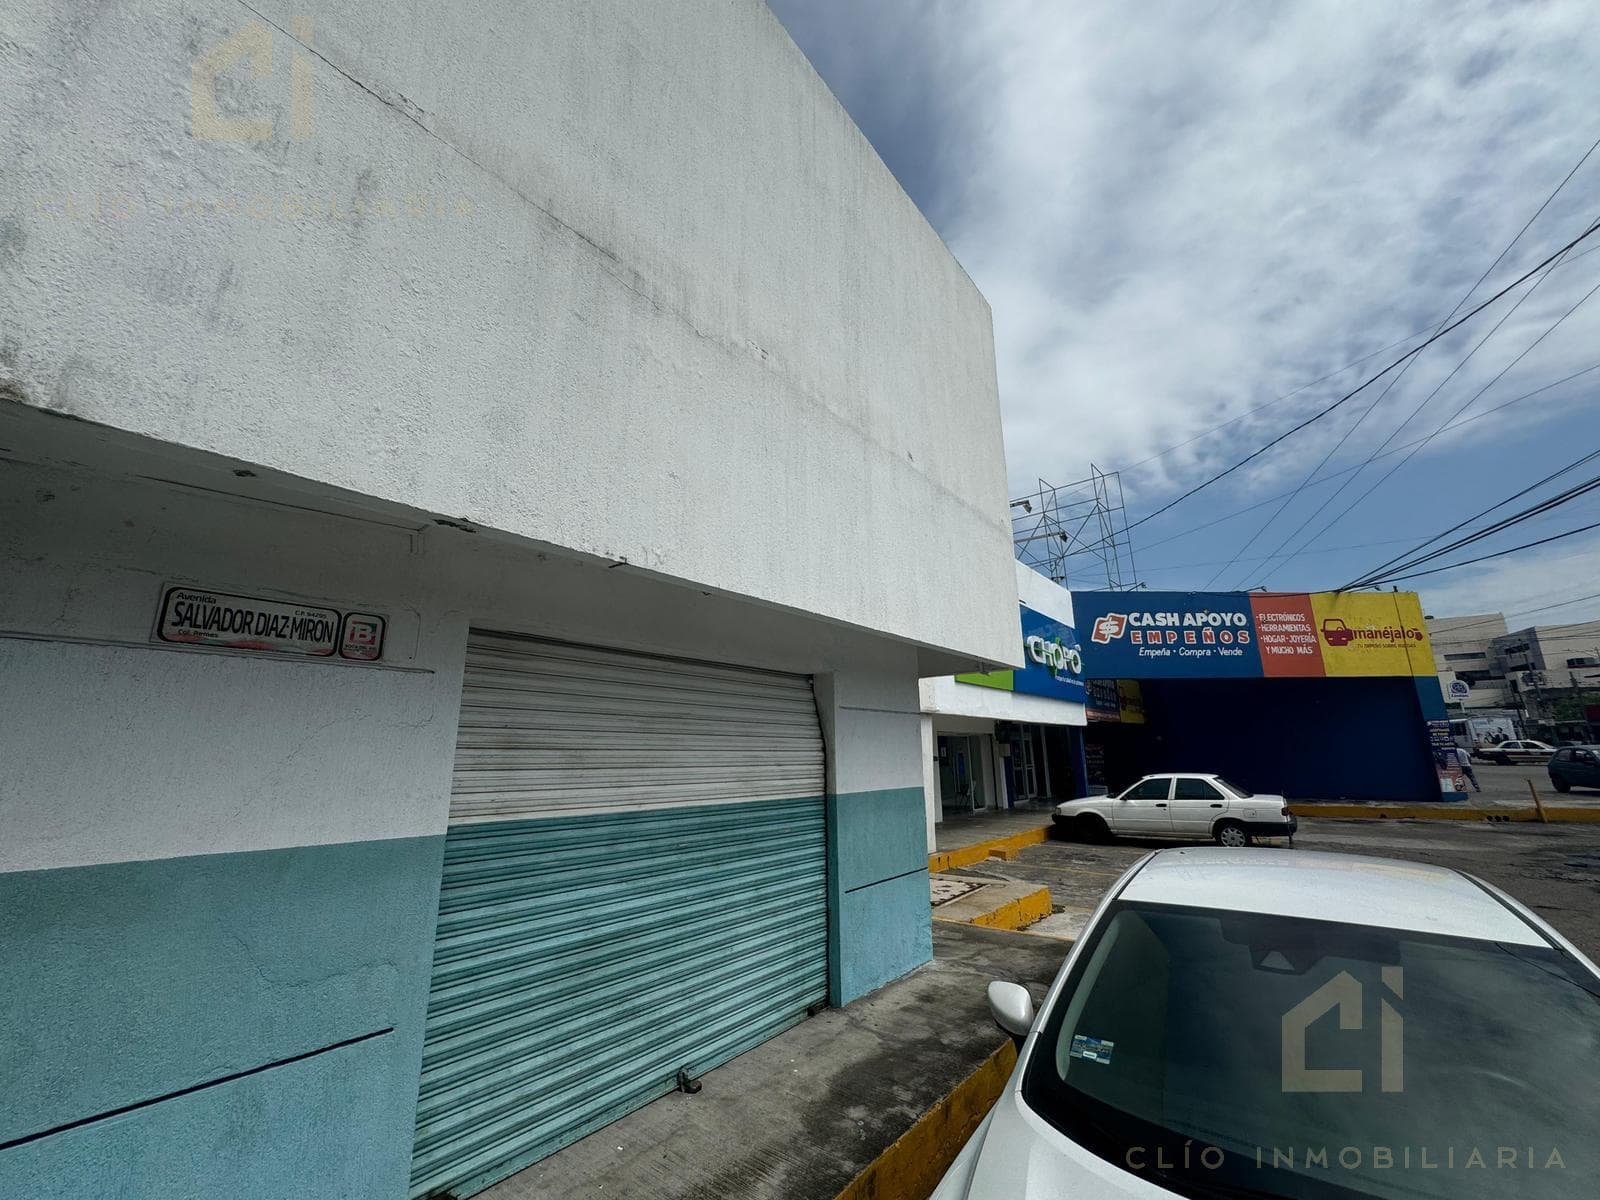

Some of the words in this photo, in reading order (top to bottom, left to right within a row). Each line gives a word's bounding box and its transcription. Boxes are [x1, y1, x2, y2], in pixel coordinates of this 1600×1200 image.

[176, 591, 217, 605] Avenida
[171, 600, 254, 635] SALVADOR
[255, 611, 289, 638] DIAZ
[290, 617, 334, 643] MIRON
[1128, 612, 1180, 627] CASH
[1182, 612, 1247, 627] APOYO
[1130, 627, 1250, 644] EMPEÑOS
[1263, 635, 1286, 643] HOGAR
[1289, 633, 1317, 643] JOYERÍA
[1354, 626, 1415, 643] manéjalo
[1027, 635, 1082, 674] CHOPO
[1139, 647, 1171, 658] Empeña
[1179, 647, 1211, 658] Compra
[1217, 647, 1243, 656] Vende
[1297, 644, 1313, 654] MÁS
